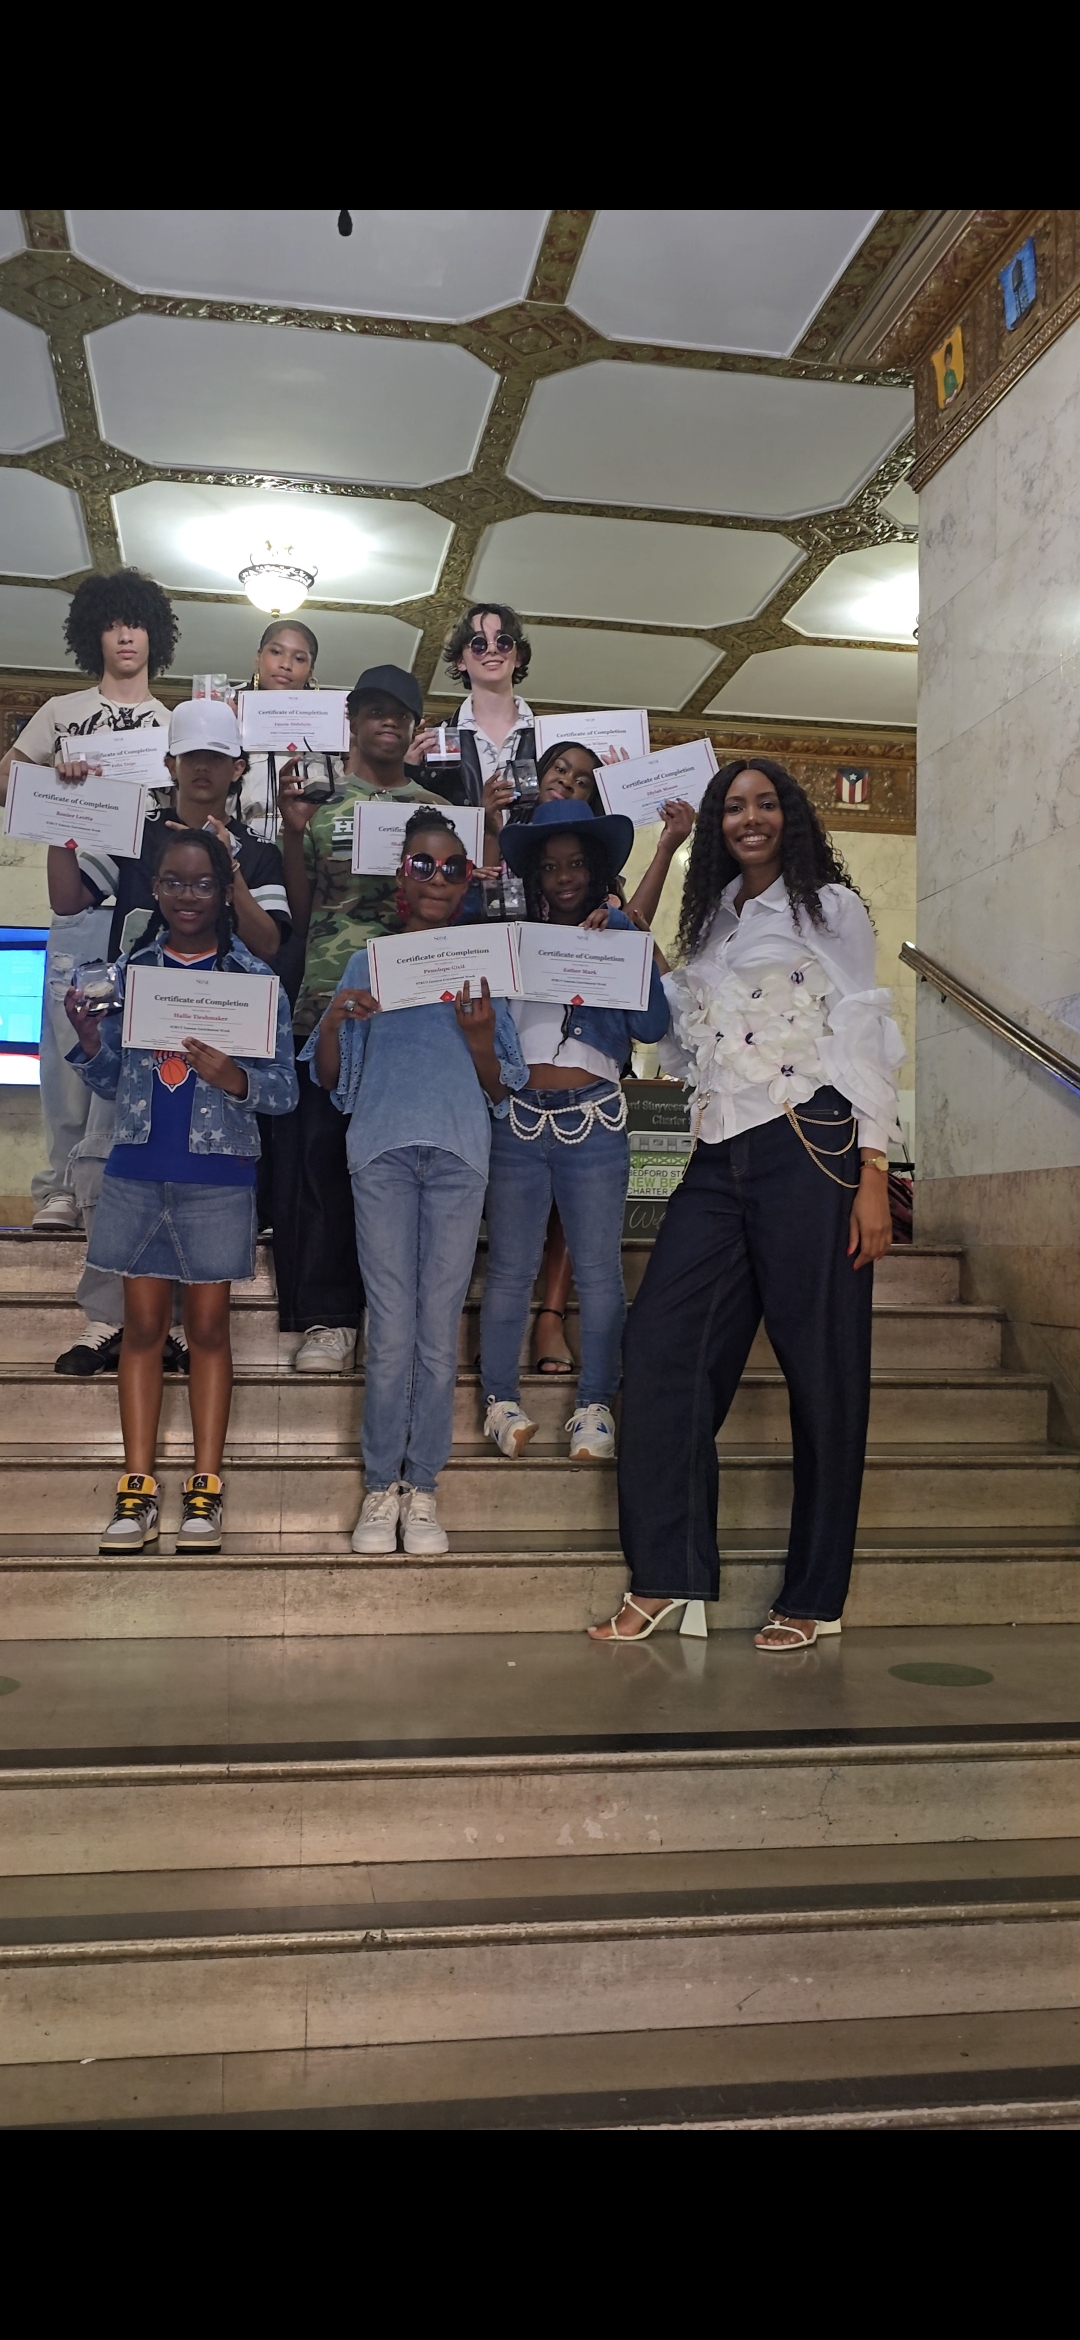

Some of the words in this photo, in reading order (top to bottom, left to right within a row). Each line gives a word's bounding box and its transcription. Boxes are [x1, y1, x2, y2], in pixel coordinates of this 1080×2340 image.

[594, 728, 626, 736] Completion
[622, 777, 653, 790] Certificate
[660, 765, 695, 780] Completion
[33, 791, 70, 804] Certificate
[79, 799, 119, 811] Completion
[396, 954, 436, 965] Certificate
[446, 948, 490, 958] Completion
[538, 949, 575, 958] Certificate
[584, 953, 625, 963] Completion
[154, 994, 194, 1004] Certificate
[195, 997, 205, 1005] of
[204, 998, 249, 1008] Completion
[652, 1114, 687, 1126] Charter
[628, 1170, 668, 1178] BEDFORD
[629, 1177, 656, 1188] NEW
[627, 1188, 668, 1196] CHARTER
